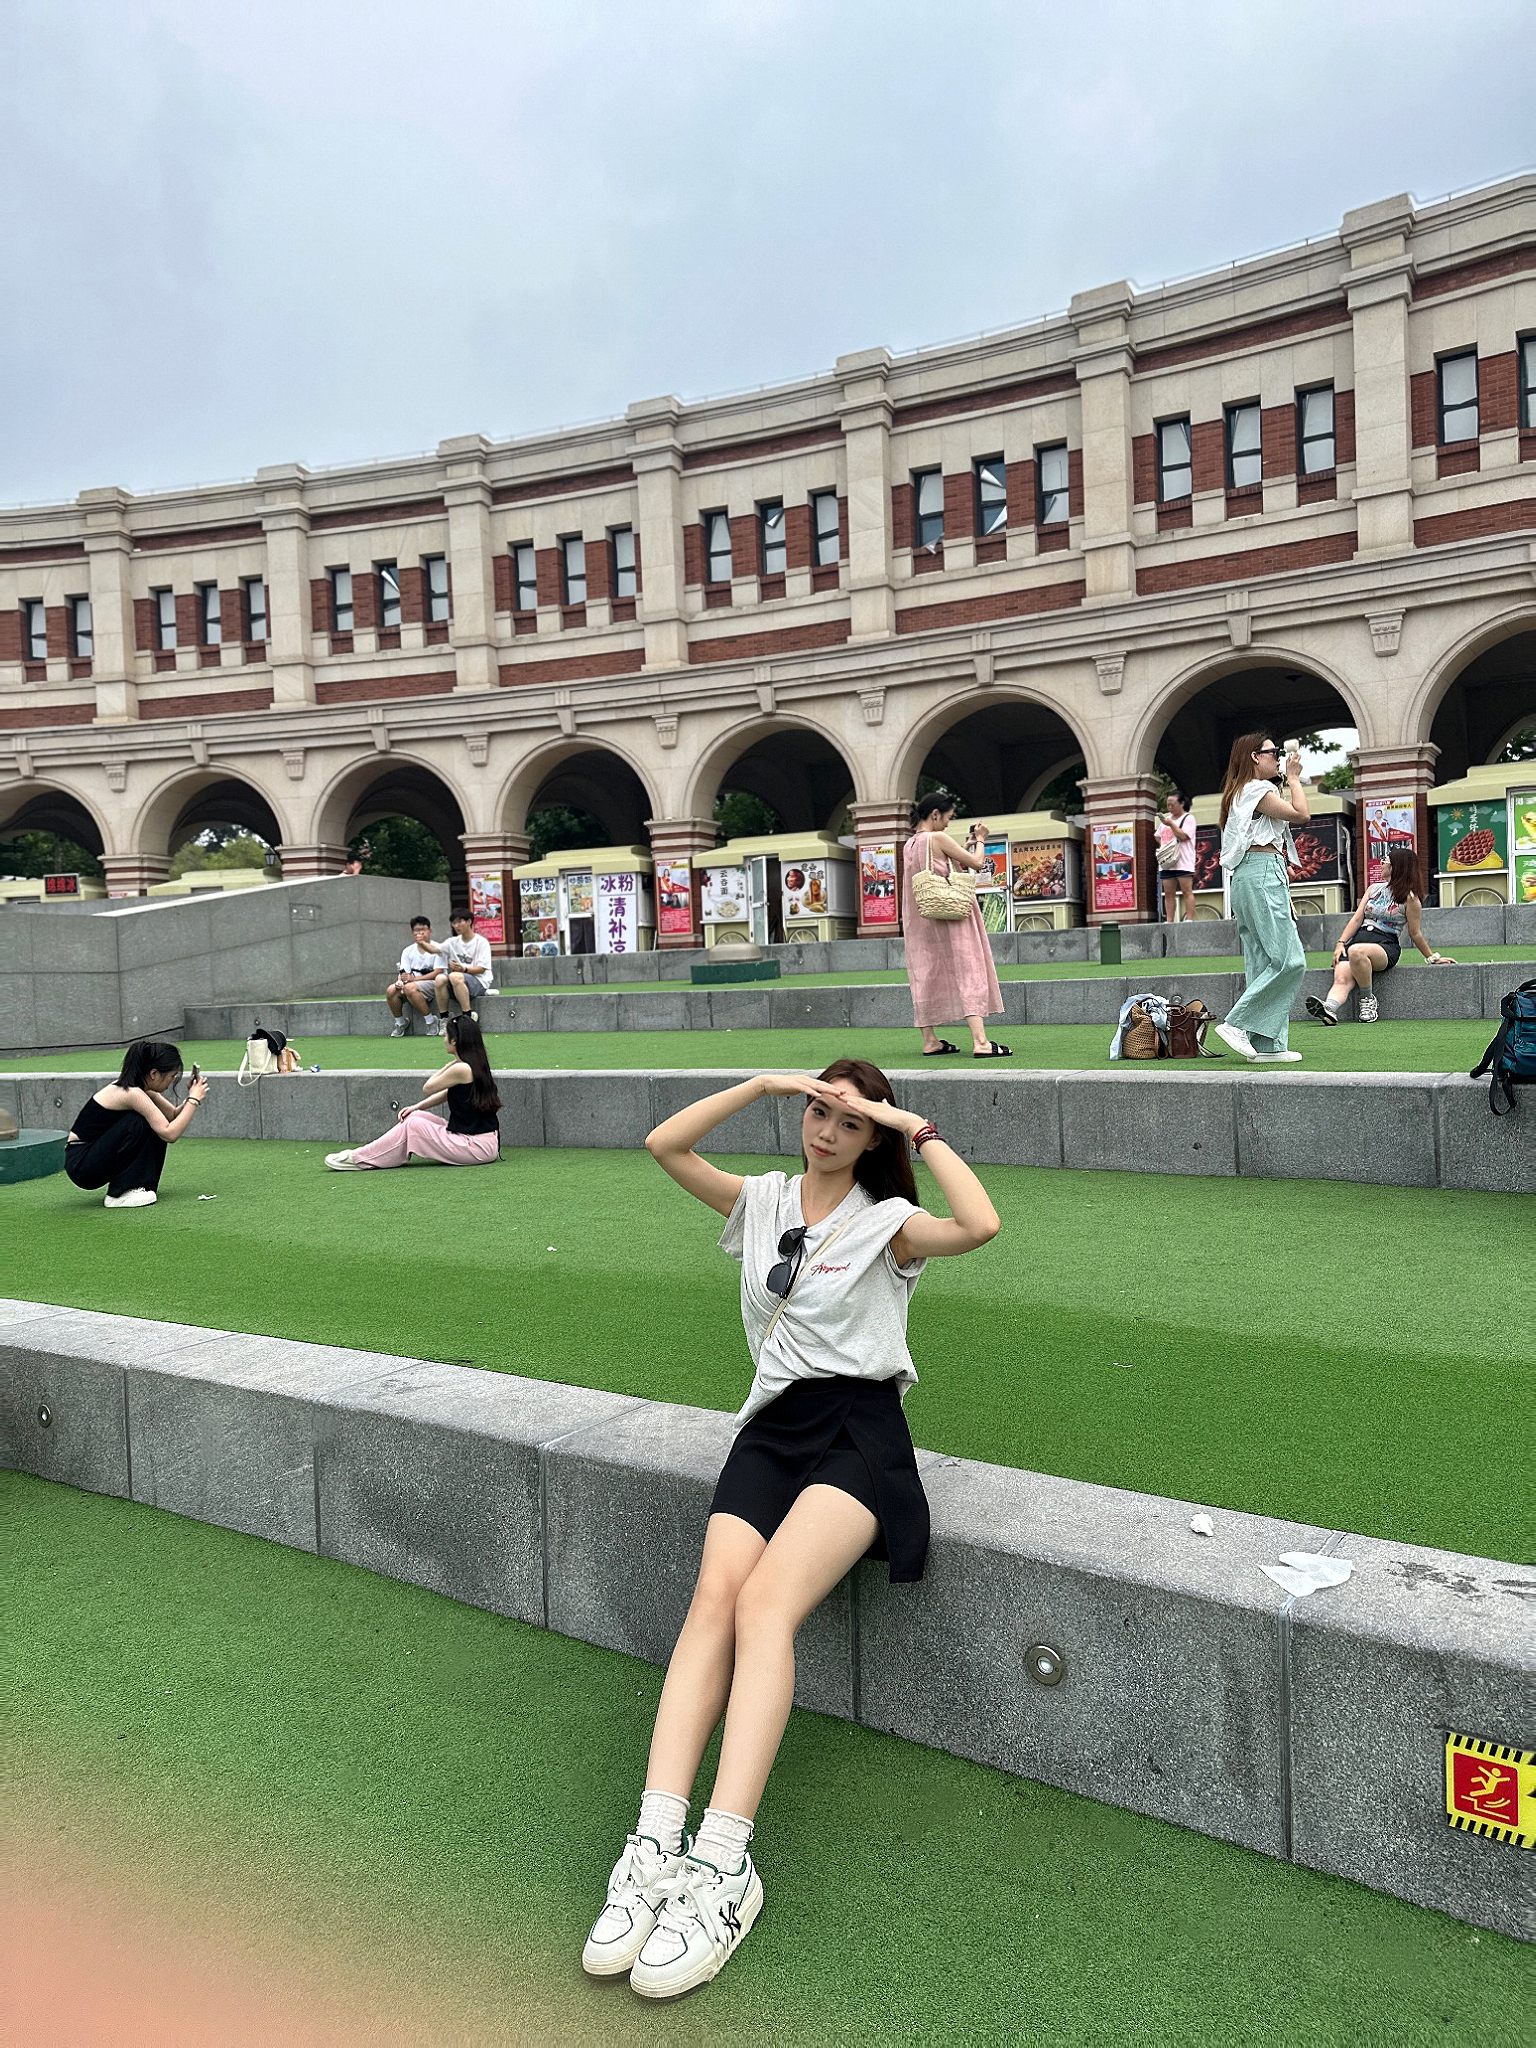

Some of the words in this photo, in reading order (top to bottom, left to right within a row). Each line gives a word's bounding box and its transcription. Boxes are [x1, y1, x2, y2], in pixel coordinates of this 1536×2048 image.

[521, 877, 556, 893] 炒酸奶
[600, 874, 634, 893] 冰粉
